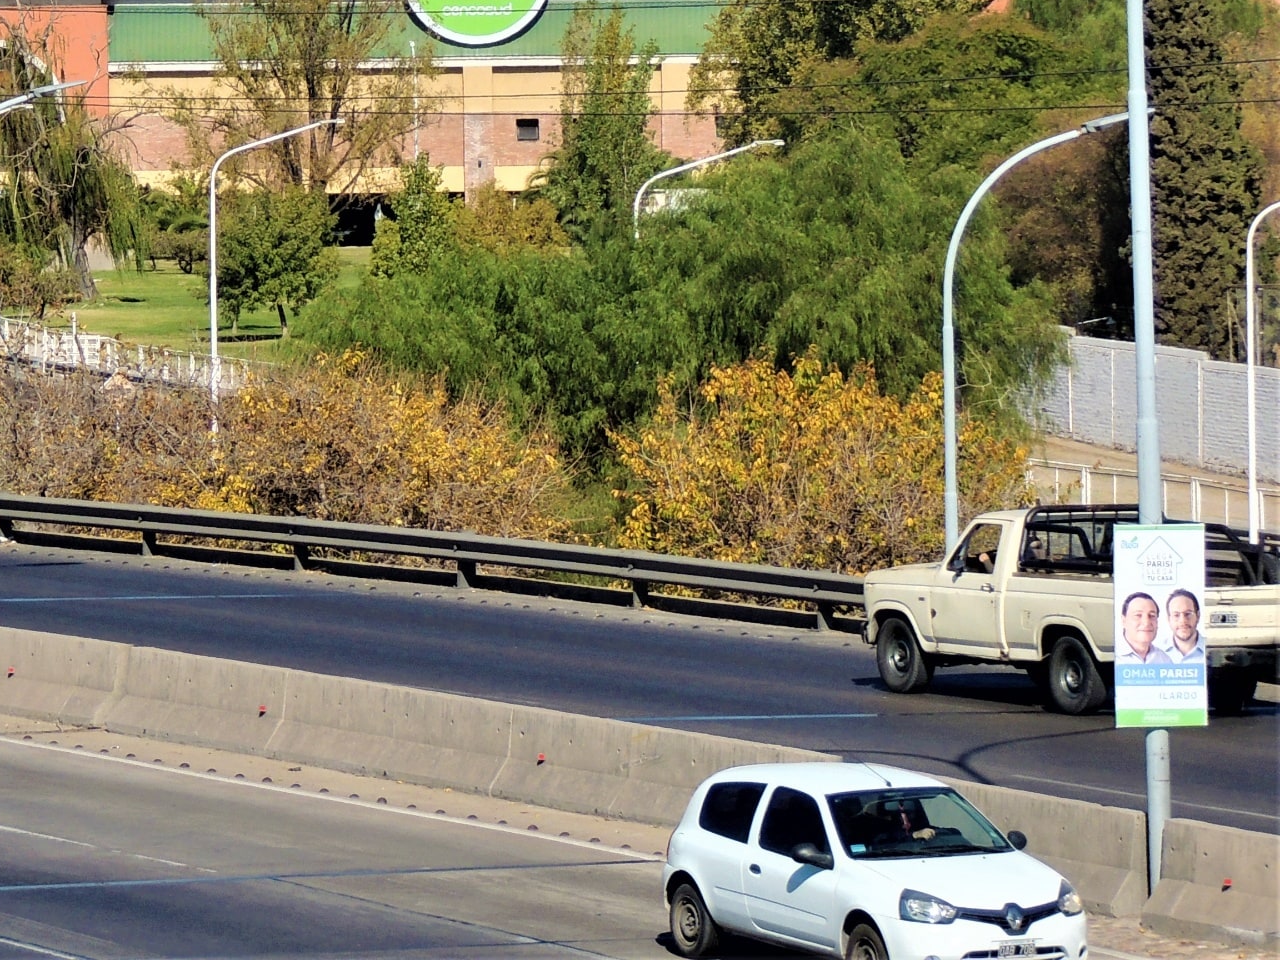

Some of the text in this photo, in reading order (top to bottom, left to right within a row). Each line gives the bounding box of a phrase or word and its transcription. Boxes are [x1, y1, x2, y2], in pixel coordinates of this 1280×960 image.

[441, 2, 513, 17] cencosud
[1146, 560, 1173, 568] PARISI
[1123, 668, 1198, 679] OMAR PARISI
[1159, 691, 1198, 701] ILARDO
